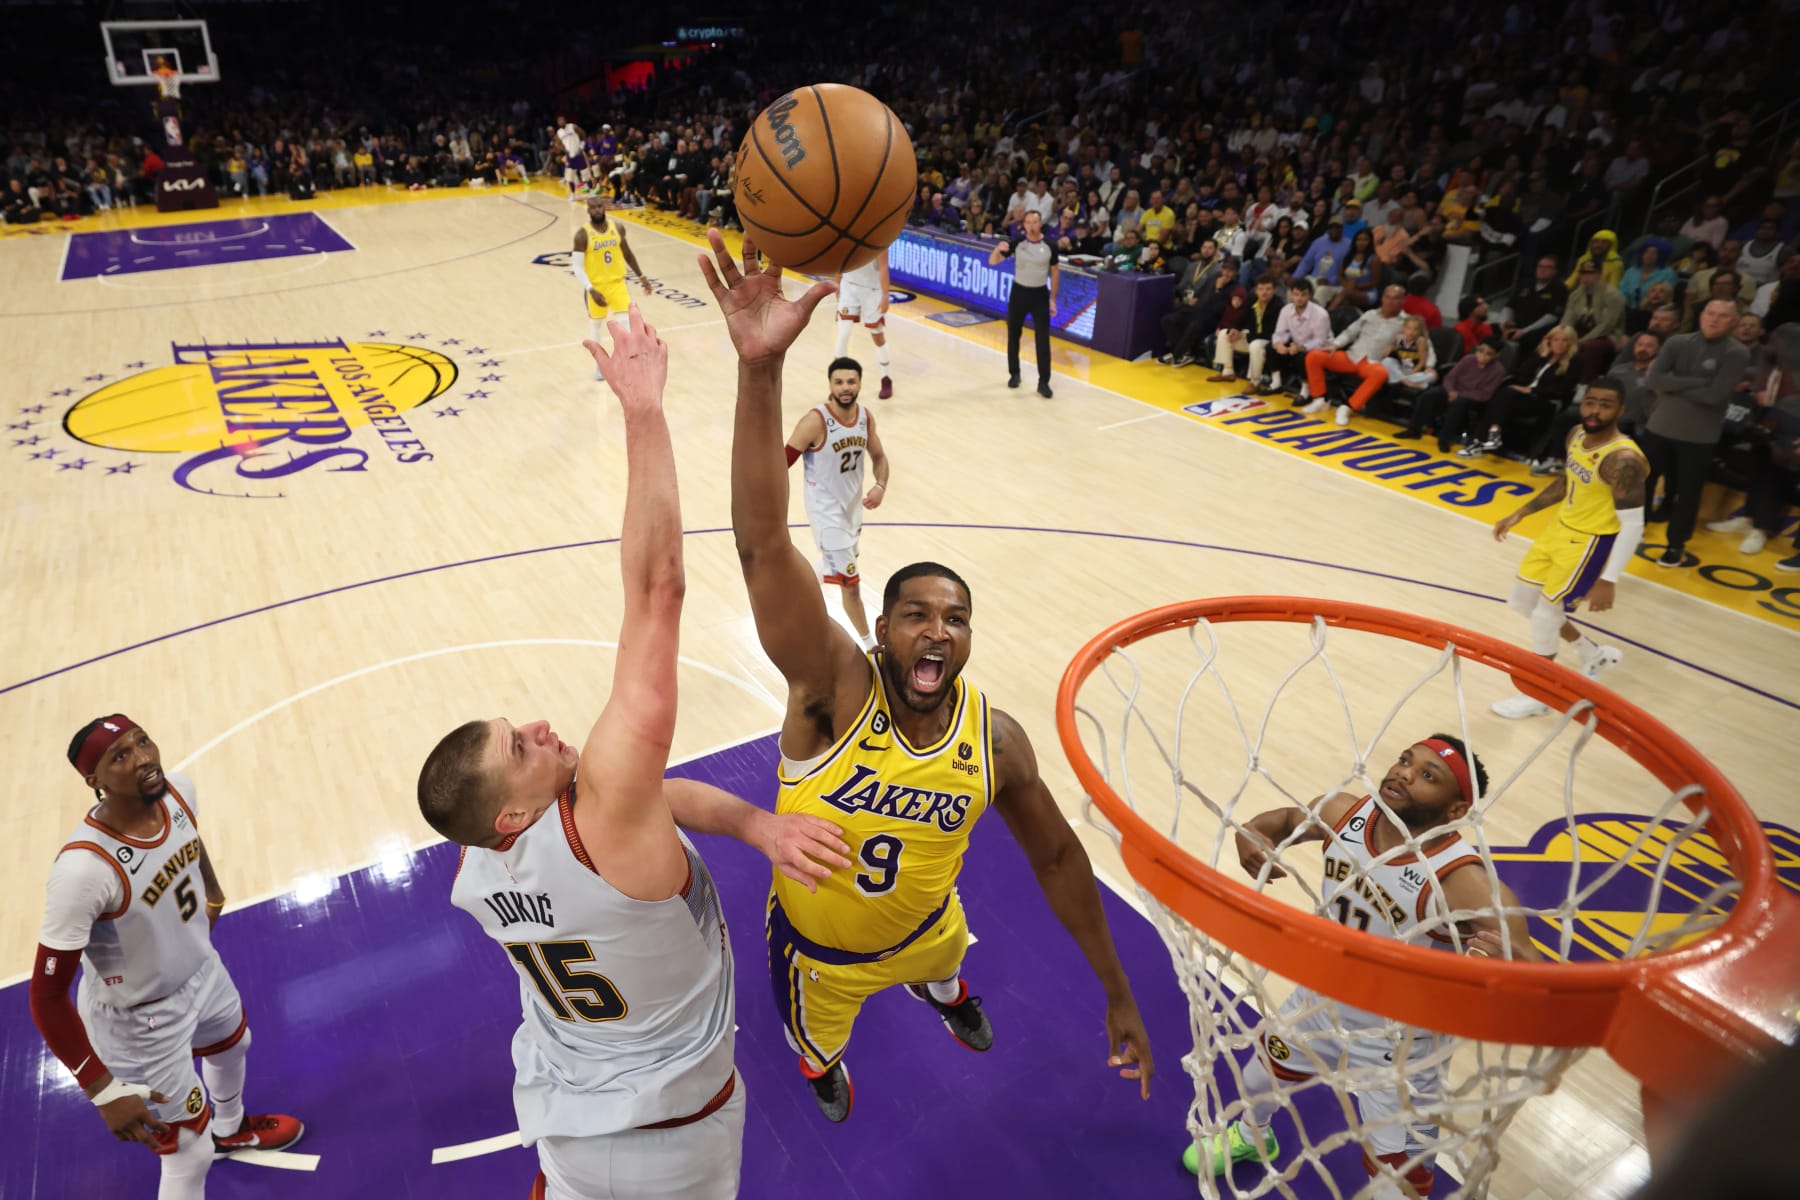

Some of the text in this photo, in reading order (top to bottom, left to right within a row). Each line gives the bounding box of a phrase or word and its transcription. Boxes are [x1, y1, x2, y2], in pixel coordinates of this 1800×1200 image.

[766, 93, 806, 170] ilson
[604, 250, 613, 264] 6
[888, 238, 949, 286] OMORROW
[950, 252, 998, 299] 8:30PM
[171, 336, 369, 498] LAKERS
[329, 356, 434, 463] LOS ANGELES
[840, 450, 863, 474] 27
[1221, 409, 1535, 507] PLAYOFFS
[873, 713, 886, 732] 6
[952, 759, 979, 775] bibigo
[819, 764, 973, 833] LAKERS
[854, 832, 904, 898] 9
[1404, 866, 1426, 886] WU
[174, 873, 198, 924] 5
[484, 892, 555, 929] JOKIĆ
[504, 939, 629, 1022] 15
